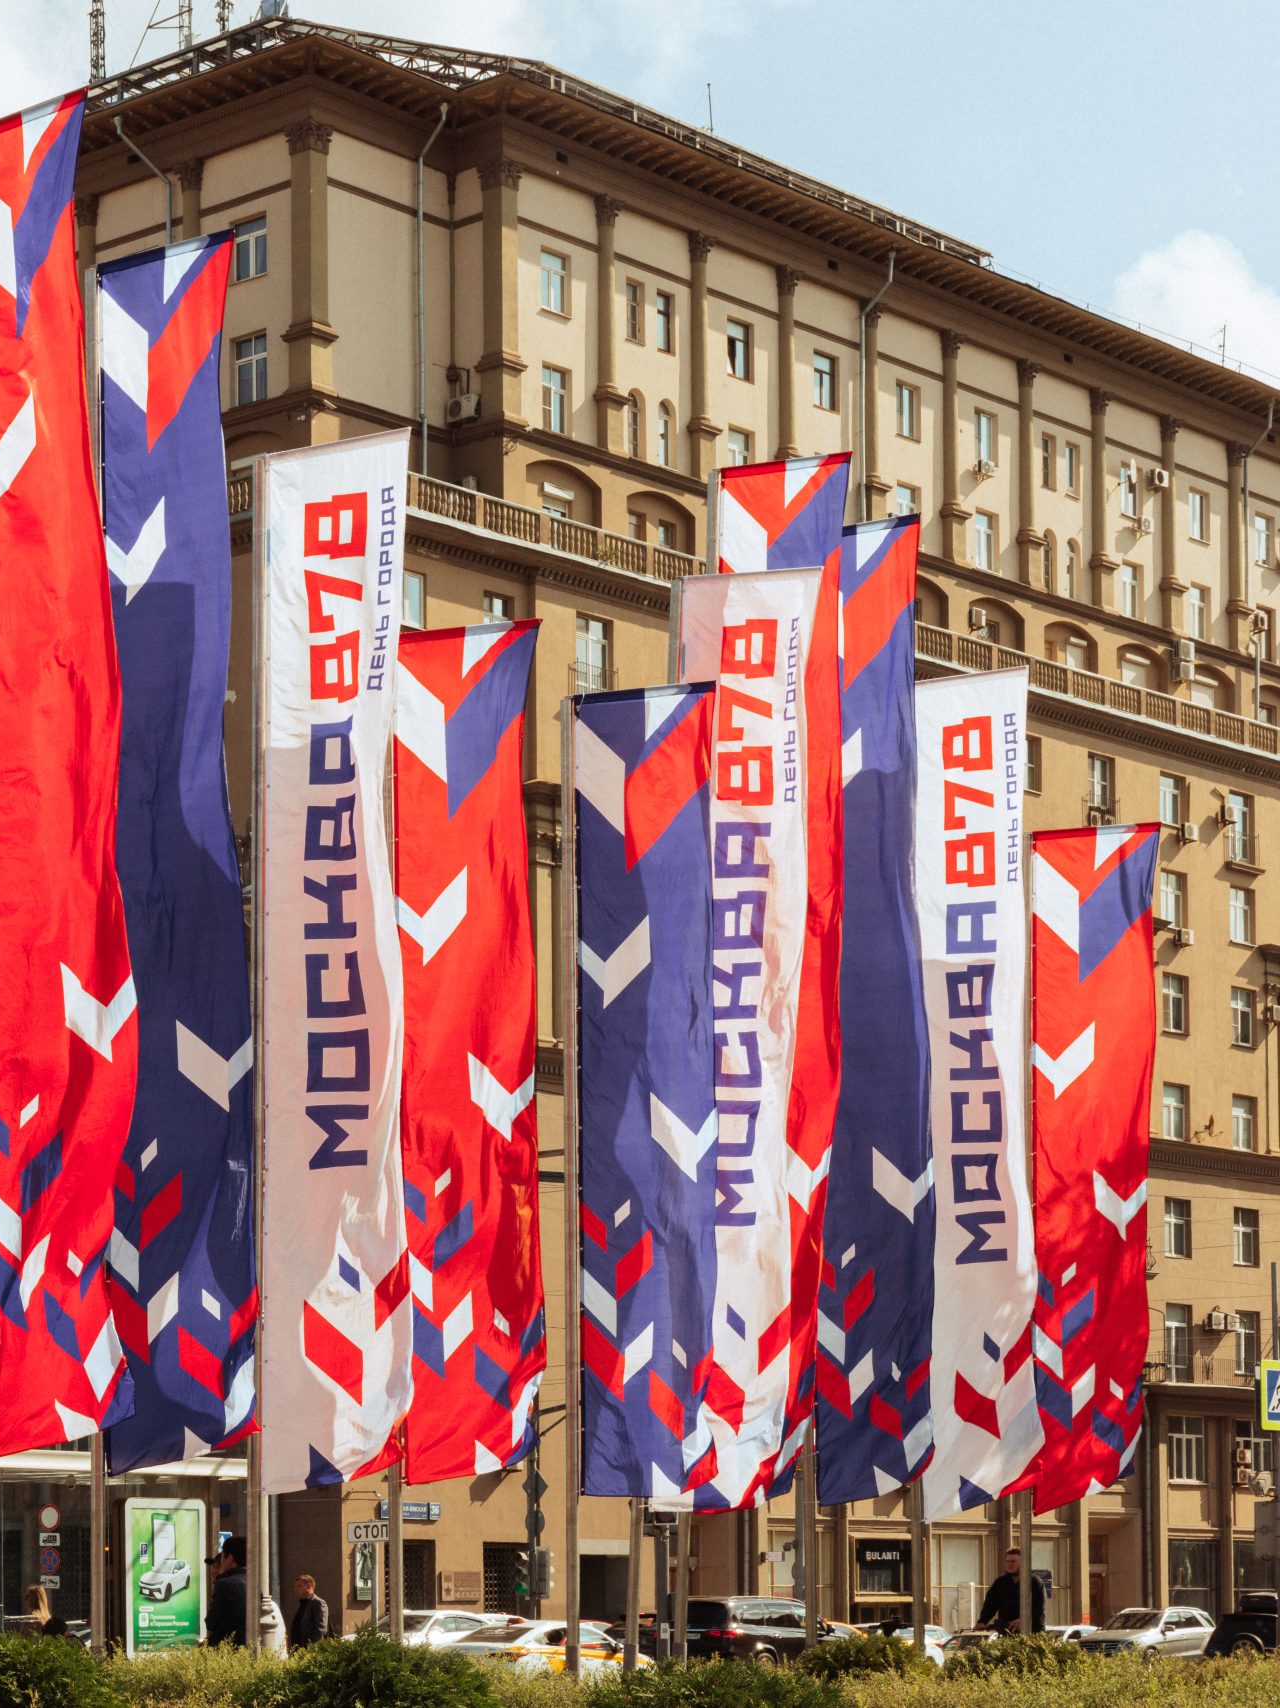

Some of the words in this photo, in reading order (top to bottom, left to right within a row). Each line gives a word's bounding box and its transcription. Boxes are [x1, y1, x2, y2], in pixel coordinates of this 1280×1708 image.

[303, 491, 368, 704] 878
[376, 485, 397, 606] ГОРОДА
[366, 614, 391, 692] ДЕНЬ
[716, 618, 778, 807] 878
[783, 730, 798, 803] ДЕНЬ
[942, 715, 997, 888] 878
[1003, 712, 1019, 811] ГОРОДА
[1006, 818, 1019, 883] ДЕНЬ
[303, 714, 371, 1171] МОСКВА
[712, 821, 772, 1228] МОСКВА
[945, 900, 1009, 1266] МОСКВА
[353, 1524, 389, 1540] СТОП
[430, 1505, 440, 1515] 36
